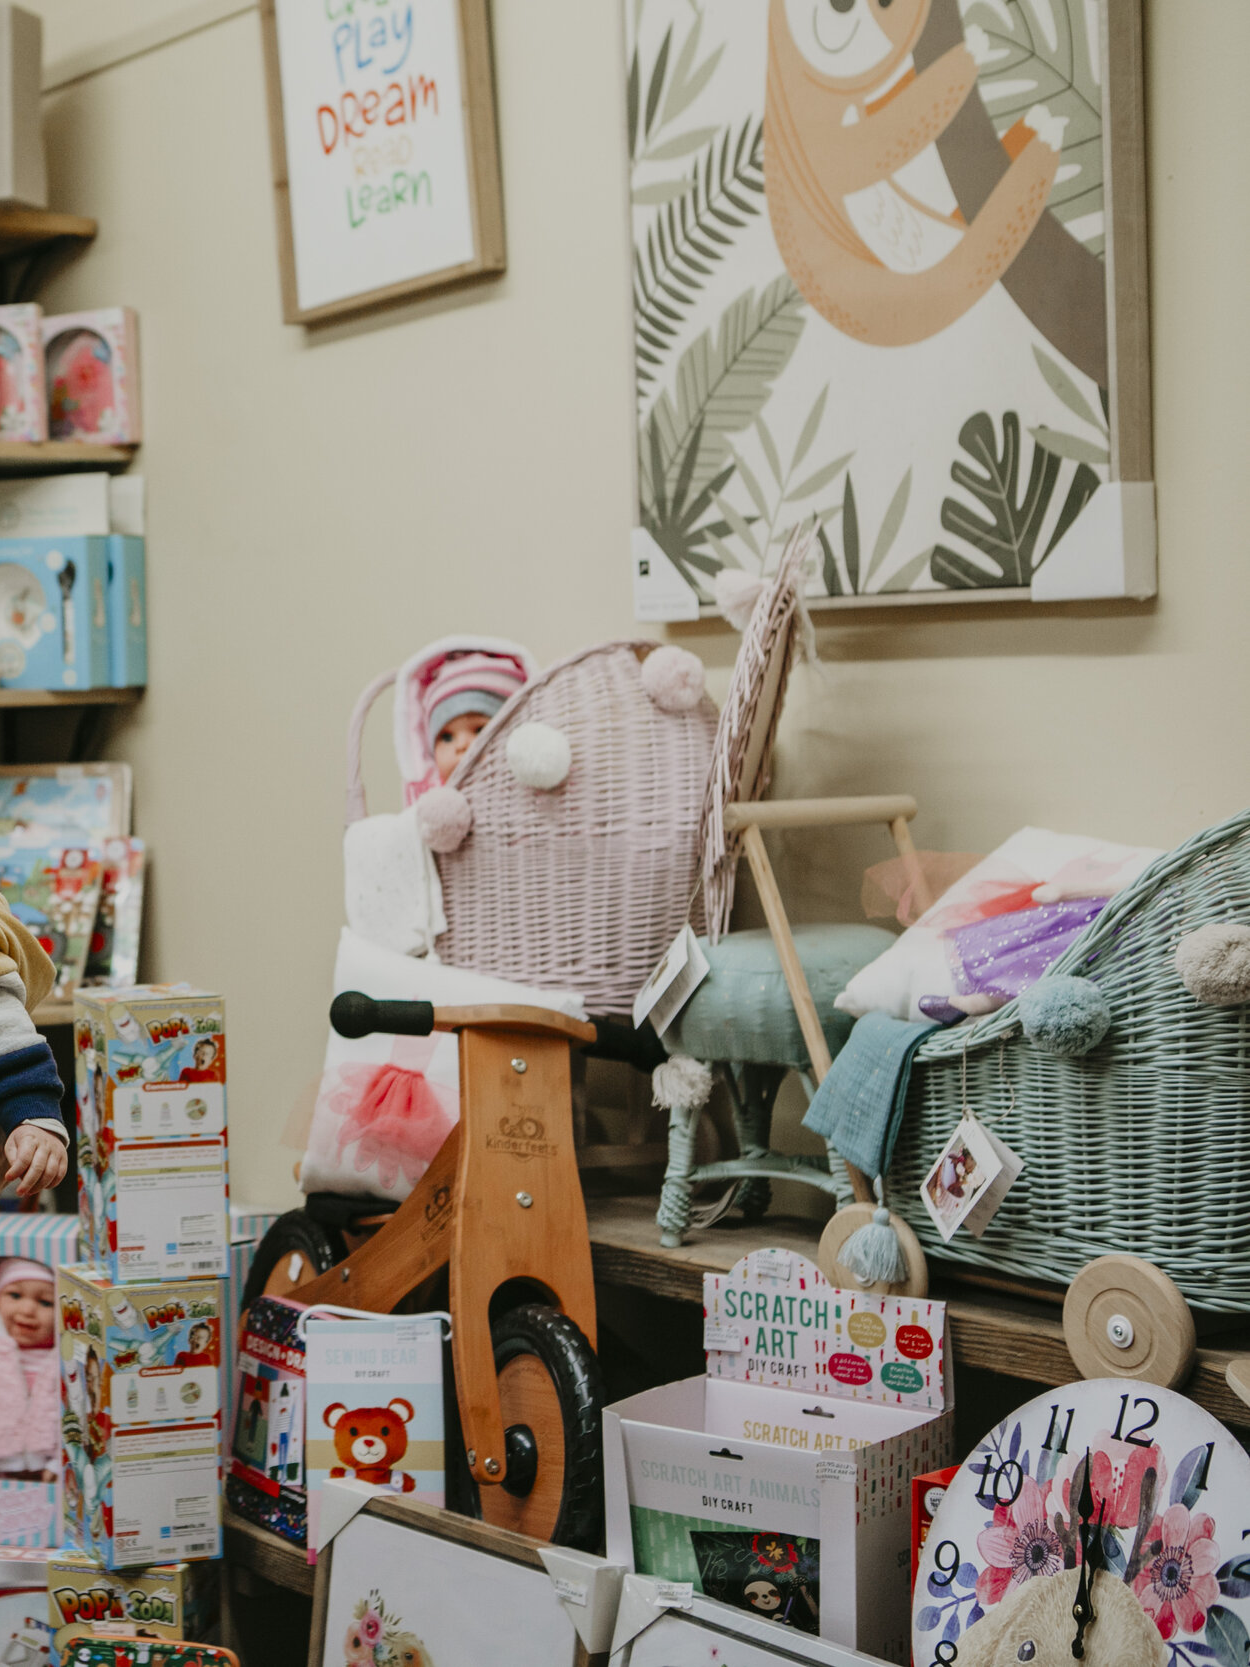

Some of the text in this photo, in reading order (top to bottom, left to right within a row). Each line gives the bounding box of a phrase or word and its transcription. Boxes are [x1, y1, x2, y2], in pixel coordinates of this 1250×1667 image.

[485, 1134, 559, 1157] kinderfeets
[724, 1288, 829, 1331] SCRATCH
[325, 1348, 418, 1365] SEWING BEAR
[755, 1326, 799, 1361] ART
[354, 1370, 391, 1379] DIY CRAFT
[748, 1358, 808, 1379] DIY CRAFT
[743, 1420, 808, 1449] SCRATCH
[813, 1432, 844, 1450] ART
[1041, 1404, 1075, 1455] 11
[1110, 1393, 1160, 1448] 12
[640, 1459, 821, 1509] SCRATCH ART ANIMALS
[975, 1454, 1024, 1507] 10
[1195, 1441, 1216, 1491] 1
[702, 1494, 753, 1515] DIY CRAFT
[929, 1540, 961, 1588] 9
